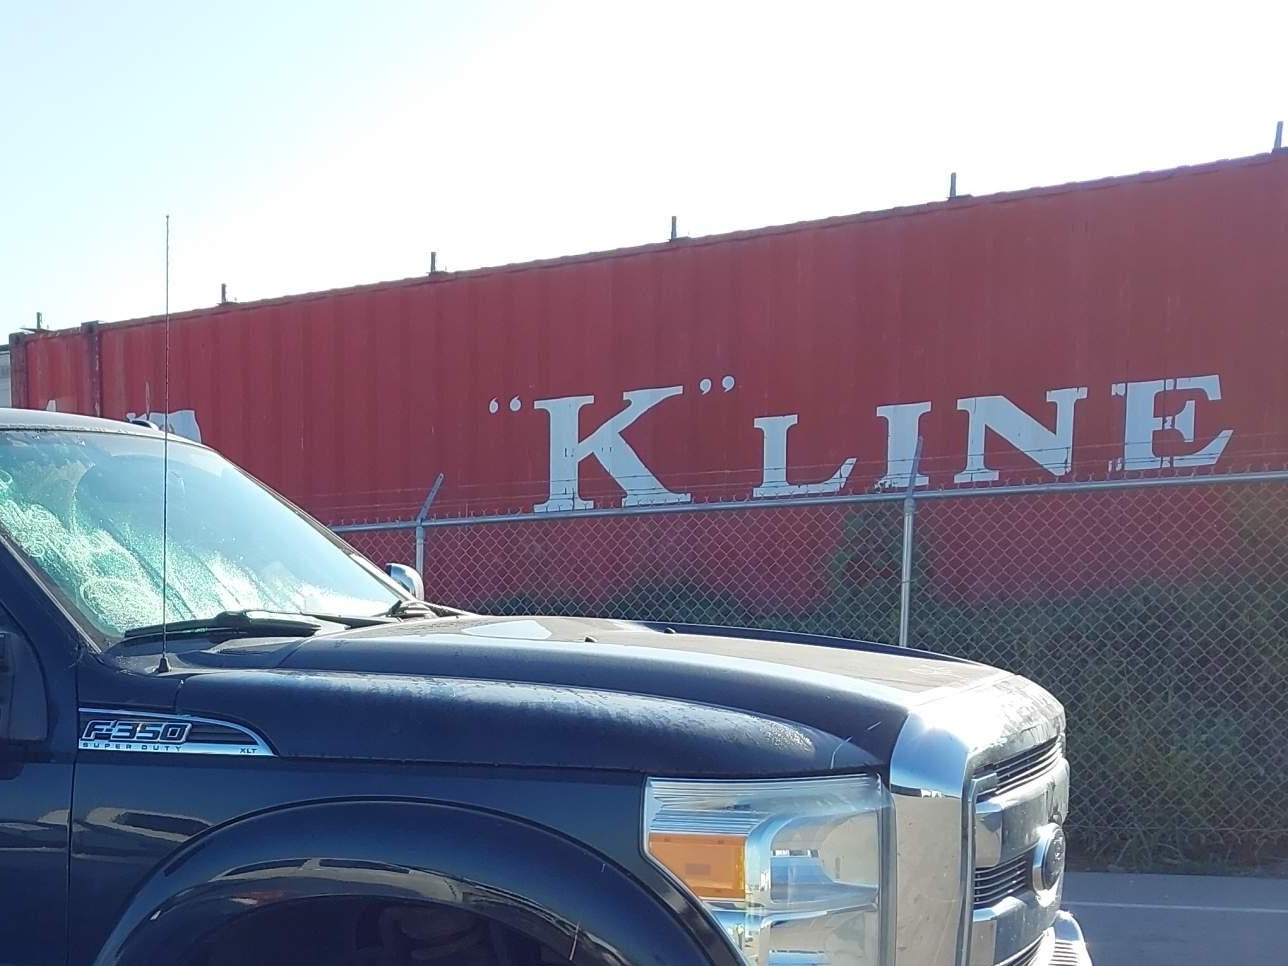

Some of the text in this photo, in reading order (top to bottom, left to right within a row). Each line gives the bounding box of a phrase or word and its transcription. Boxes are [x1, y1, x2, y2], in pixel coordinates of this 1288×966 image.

[753, 375, 1234, 498] LINE
[82, 720, 192, 742] F-350
[82, 742, 132, 750] SUPER
[141, 744, 183, 752] DUTY
